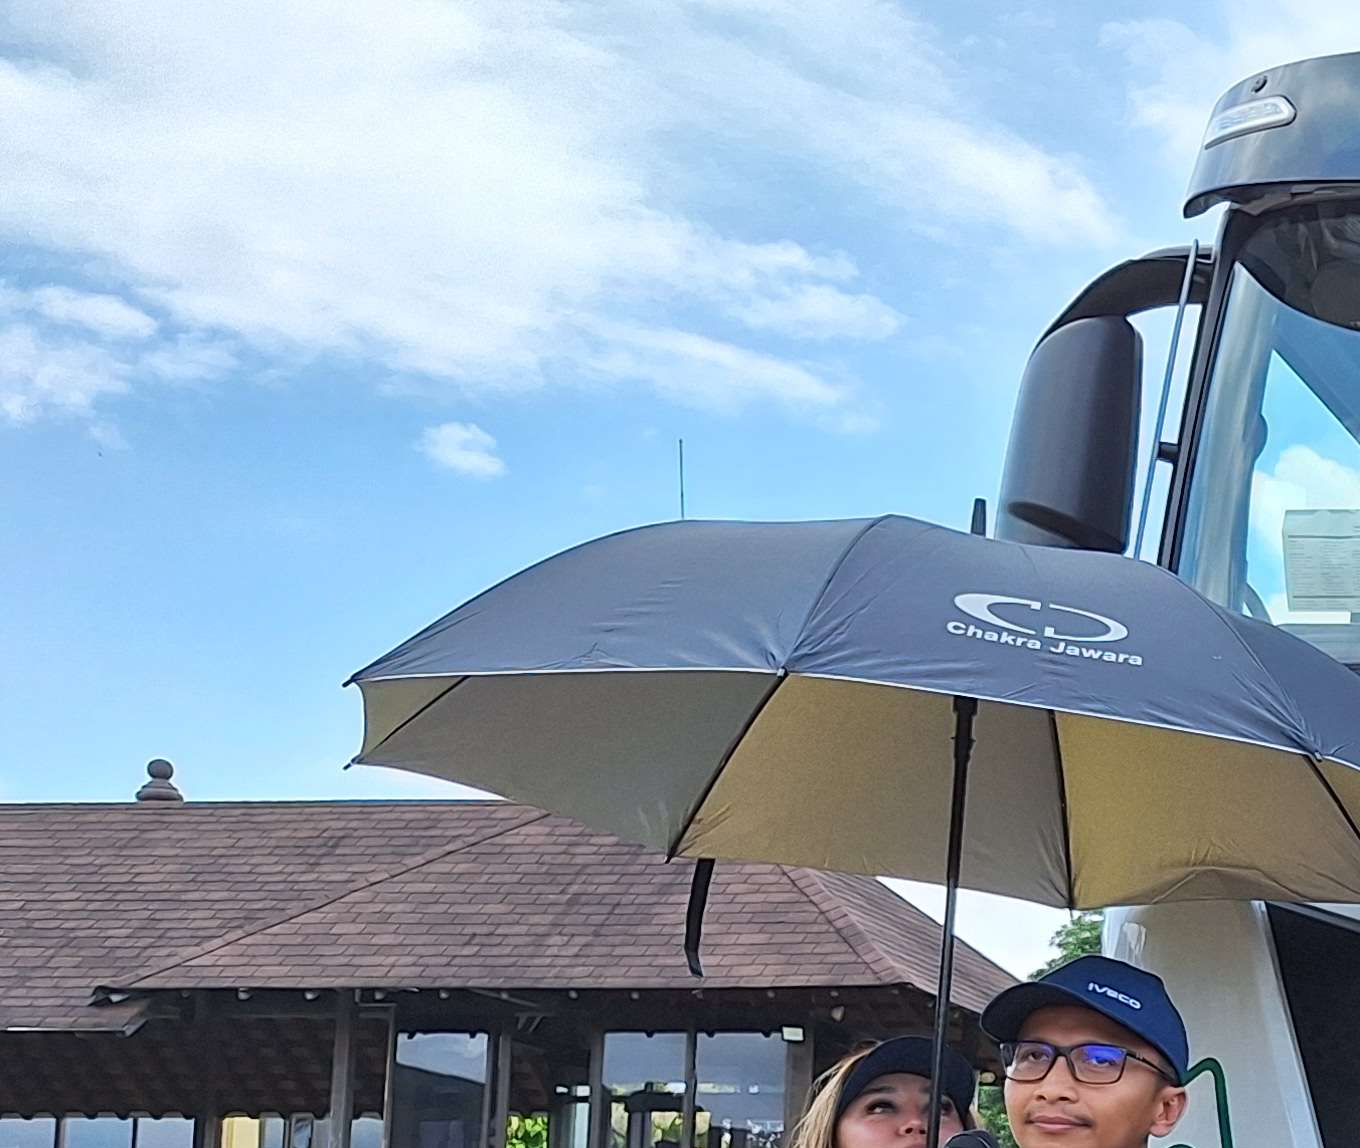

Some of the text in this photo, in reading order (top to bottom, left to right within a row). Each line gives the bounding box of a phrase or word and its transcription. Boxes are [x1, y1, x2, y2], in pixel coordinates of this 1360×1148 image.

[946, 621, 1143, 667] Chakra Jawara
[1088, 982, 1141, 1009] IVECO
